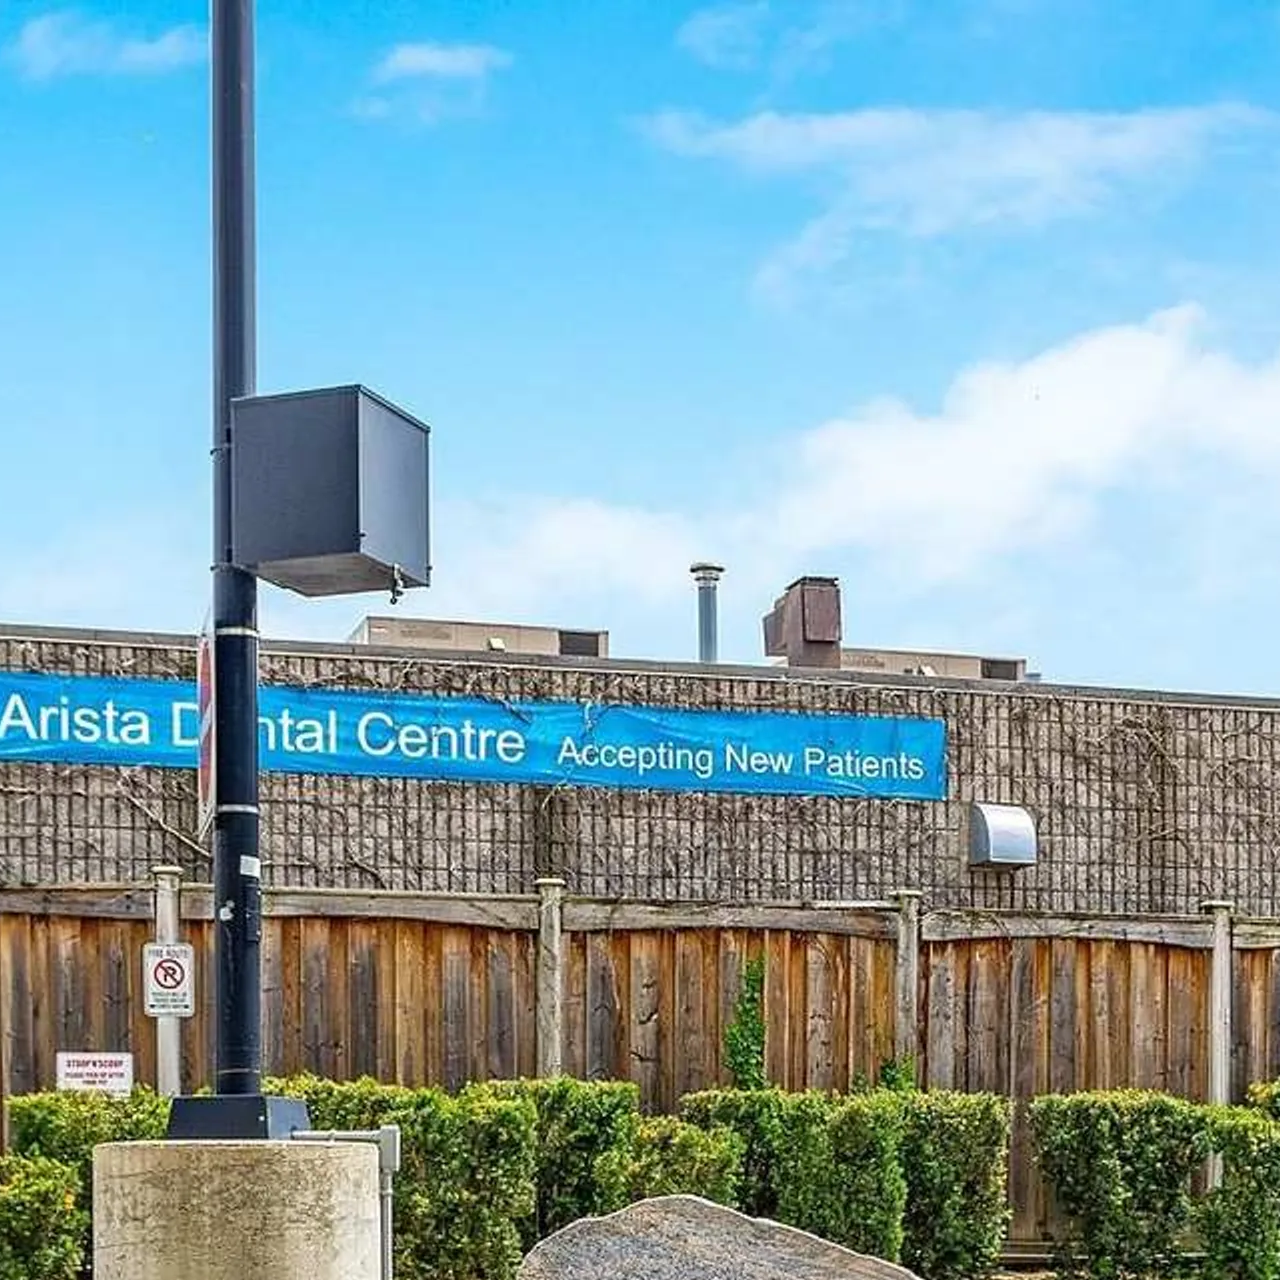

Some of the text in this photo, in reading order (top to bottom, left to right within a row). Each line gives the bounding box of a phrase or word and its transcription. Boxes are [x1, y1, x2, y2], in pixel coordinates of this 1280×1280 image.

[172, 701, 337, 754] Dntal
[358, 711, 526, 762] Centre
[557, 735, 924, 780] Accepting New Patients
